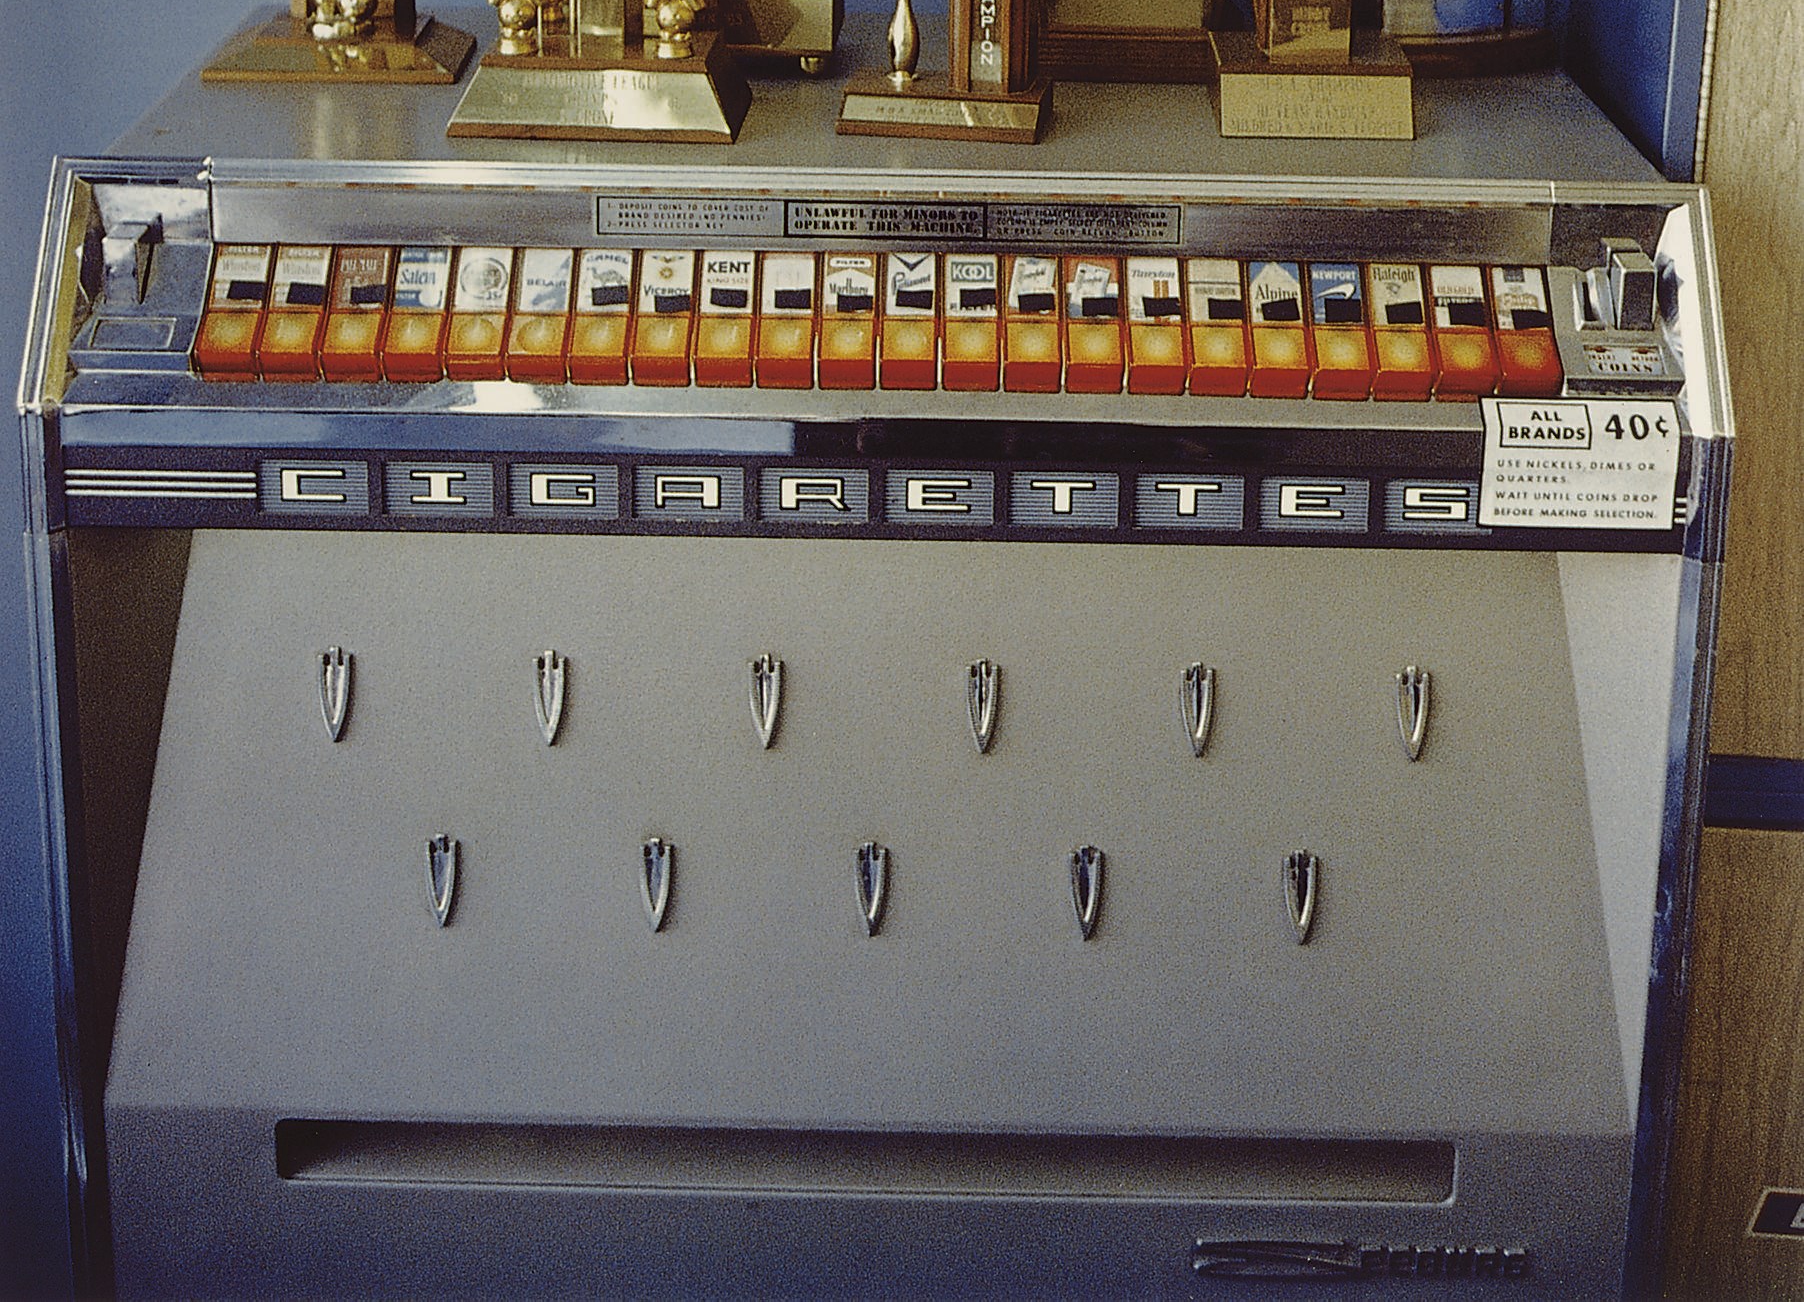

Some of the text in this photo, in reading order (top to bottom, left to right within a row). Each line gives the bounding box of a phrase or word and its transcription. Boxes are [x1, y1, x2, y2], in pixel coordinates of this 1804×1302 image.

[619, 202, 652, 210] DEPOSIT
[687, 203, 698, 211] TO
[734, 204, 753, 212] COST
[654, 212, 694, 220] DESIRED
[794, 207, 978, 221] UNLAWFUL FOR MINORS TO
[1104, 210, 1119, 219] NOT
[653, 221, 700, 229] SELECTOR
[794, 219, 857, 230] OPERATE
[866, 220, 901, 232] THIS
[1014, 228, 1042, 236] PRESS
[1053, 228, 1075, 236] COIN
[586, 253, 629, 265] CAMEL
[707, 261, 751, 274] KENT
[952, 263, 994, 281] KOOL
[1130, 268, 1176, 279] Tareyton
[400, 268, 436, 285] Salem
[1311, 269, 1358, 282] NEWPORT
[1372, 267, 1417, 283] Raleigh
[1255, 283, 1299, 300] Alpine
[1598, 362, 1654, 373] COINS
[1530, 410, 1670, 441] ALL 40¢
[1508, 427, 1586, 440] BRANDS
[1497, 459, 1520, 468] USE
[1590, 461, 1632, 471] DIMES
[1638, 462, 1656, 471] OR
[280, 469, 1470, 521] CIGARETTES
[1495, 491, 1658, 503] WAIT UNTIL COINS DROP
[1494, 508, 1534, 517] BEFORE
[1540, 508, 1588, 518] MAKING
